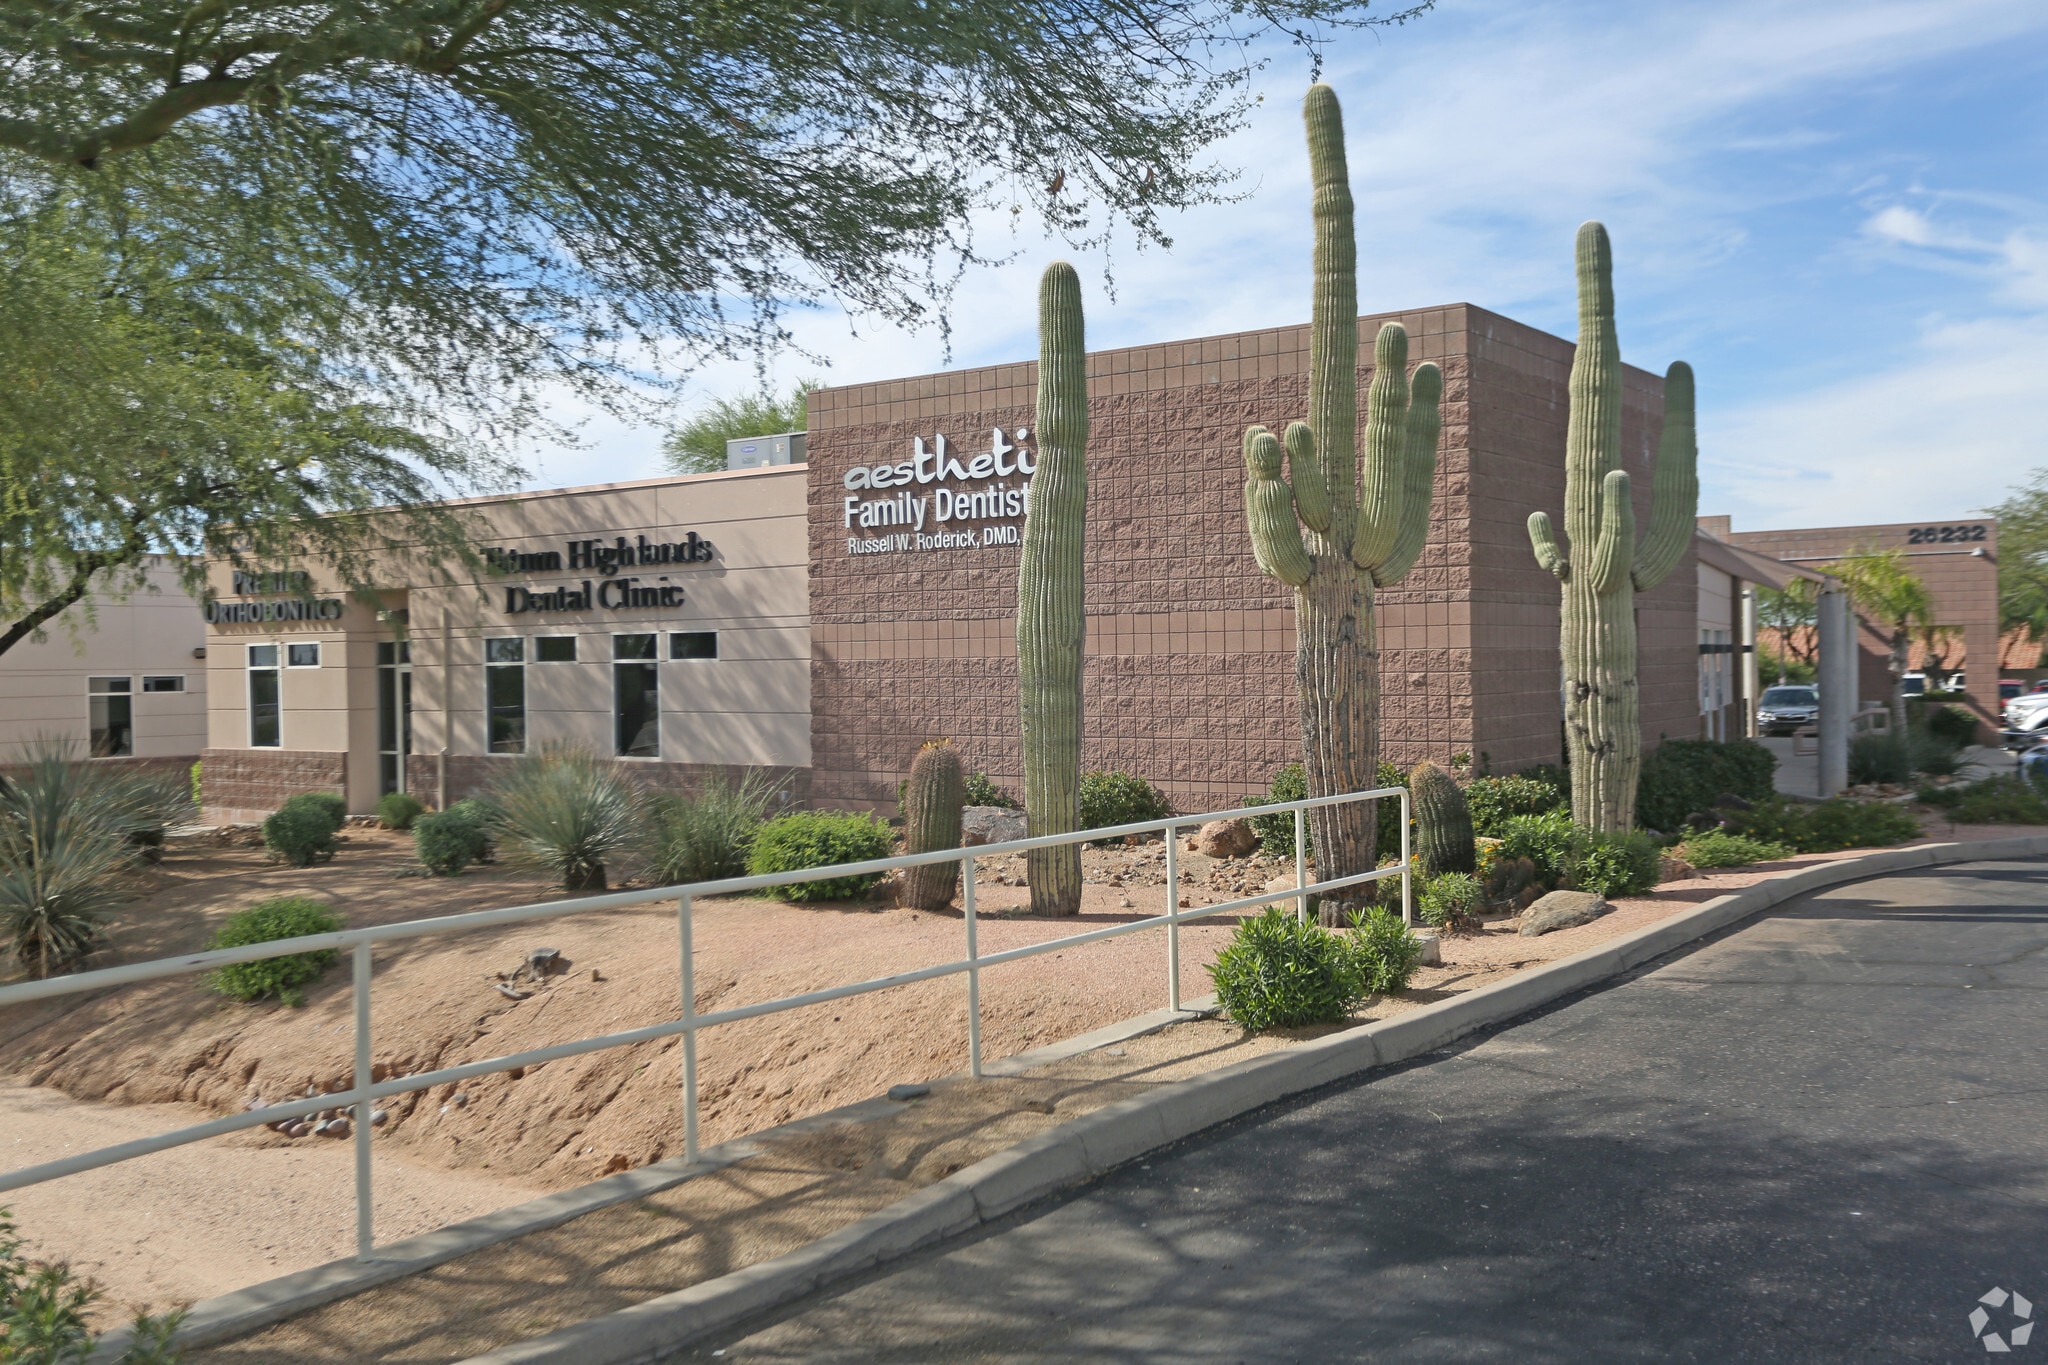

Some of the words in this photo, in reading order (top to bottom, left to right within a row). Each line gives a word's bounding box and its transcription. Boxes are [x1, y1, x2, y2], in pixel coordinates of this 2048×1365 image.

[844, 491, 927, 531] Family
[848, 535, 894, 554] Russell
[897, 533, 913, 551] W.
[917, 529, 980, 550] Roderick,
[984, 525, 1021, 546] DMD,
[1908, 524, 1987, 545] 26232
[566, 531, 713, 576] Highlands
[204, 598, 343, 625] ORTHODONTICS
[504, 580, 593, 614] Dental
[598, 576, 685, 609] Clinic
